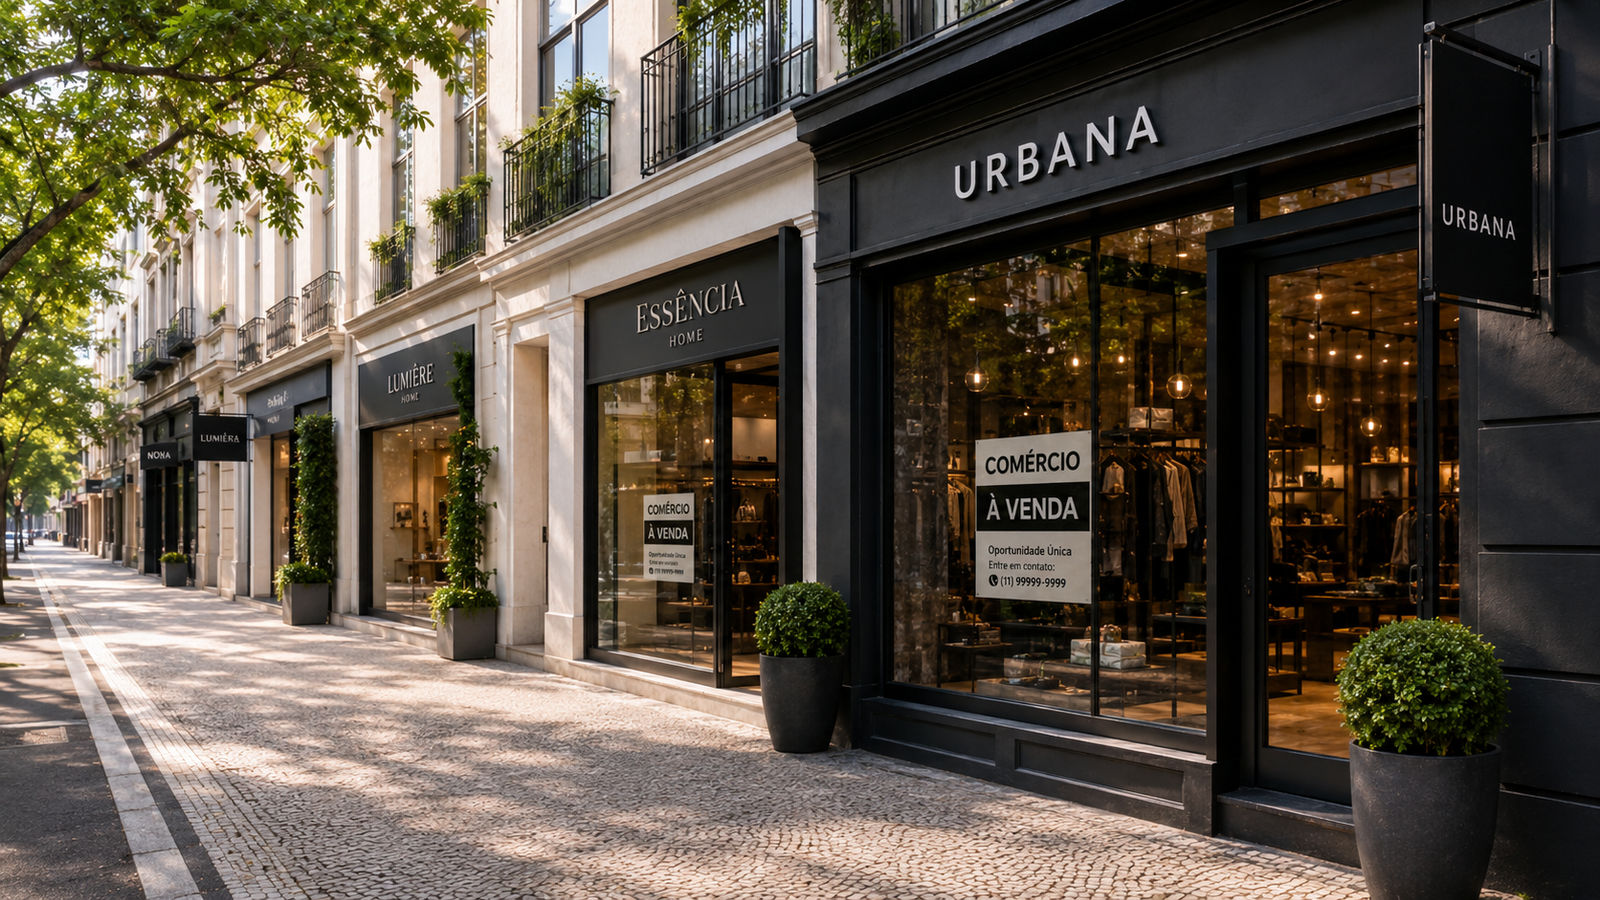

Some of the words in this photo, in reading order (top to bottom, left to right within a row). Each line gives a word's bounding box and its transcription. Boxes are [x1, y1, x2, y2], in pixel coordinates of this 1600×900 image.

[954, 105, 1159, 199] URBANA
[1442, 203, 1516, 241] URBANA
[636, 280, 745, 333] ESSÊNCIA
[669, 328, 704, 347] HOME
[985, 449, 1080, 475] COMÉRCIO
[647, 501, 690, 515] COMÉRCIO
[986, 492, 1001, 520] À
[1005, 496, 1079, 520] VENDA
[647, 523, 655, 539] À
[657, 527, 689, 540] VENDA
[988, 545, 1045, 557] Oportunidade
[1047, 544, 1072, 556] Única
[988, 560, 1008, 570] Entre
[1023, 563, 1055, 571] contato:
[1000, 575, 1014, 587] (11)
[1015, 576, 1067, 588] 99999-9999
